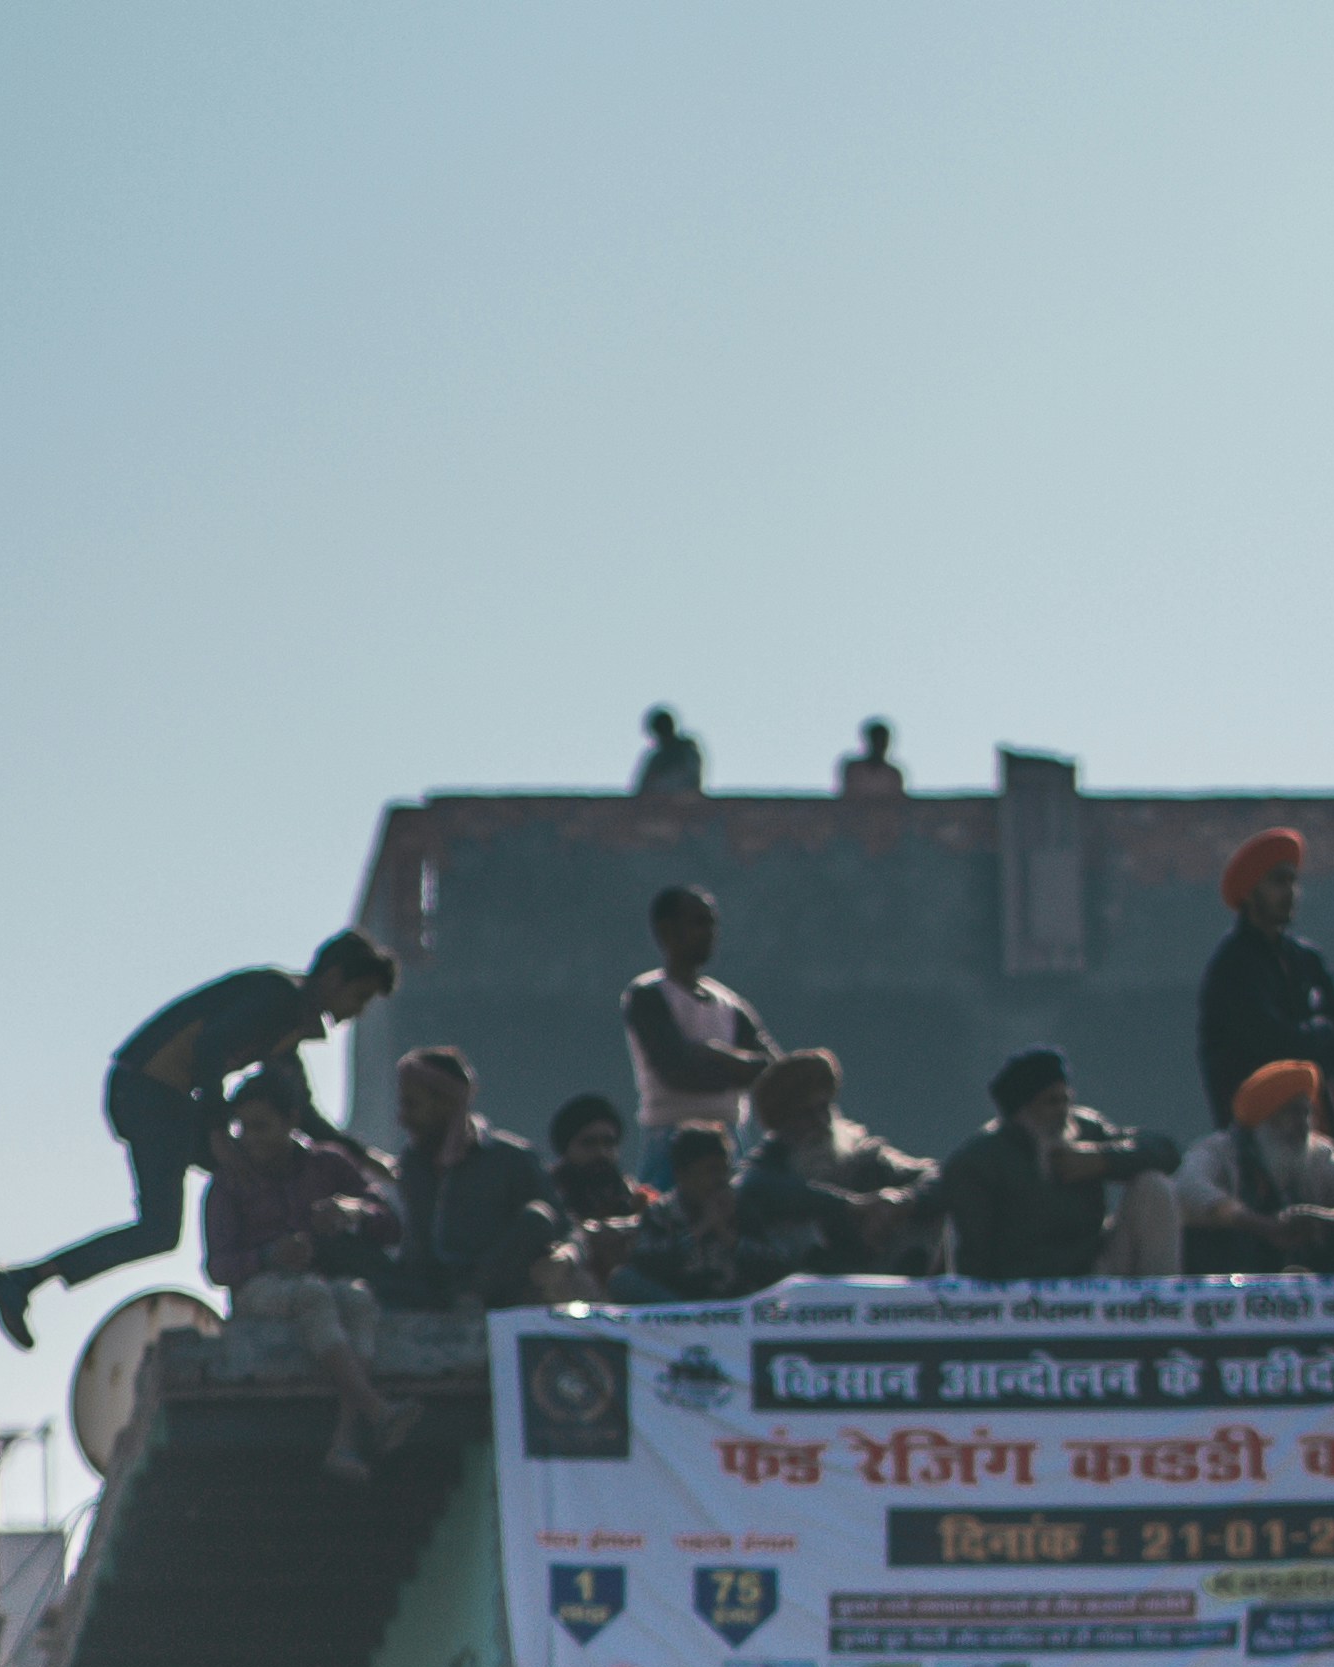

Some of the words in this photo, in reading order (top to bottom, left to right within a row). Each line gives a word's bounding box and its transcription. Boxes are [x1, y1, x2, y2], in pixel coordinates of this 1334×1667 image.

[769, 1352, 919, 1401] किसान
[938, 1348, 1140, 1402] आन्दोलन
[1153, 1347, 1205, 1398] के
[713, 1425, 827, 1486] फंड
[837, 1424, 1037, 1487] रेजिंग
[938, 1512, 1084, 1563] दिनांक
[575, 1569, 595, 1601] 1
[711, 1570, 762, 1605] 75
